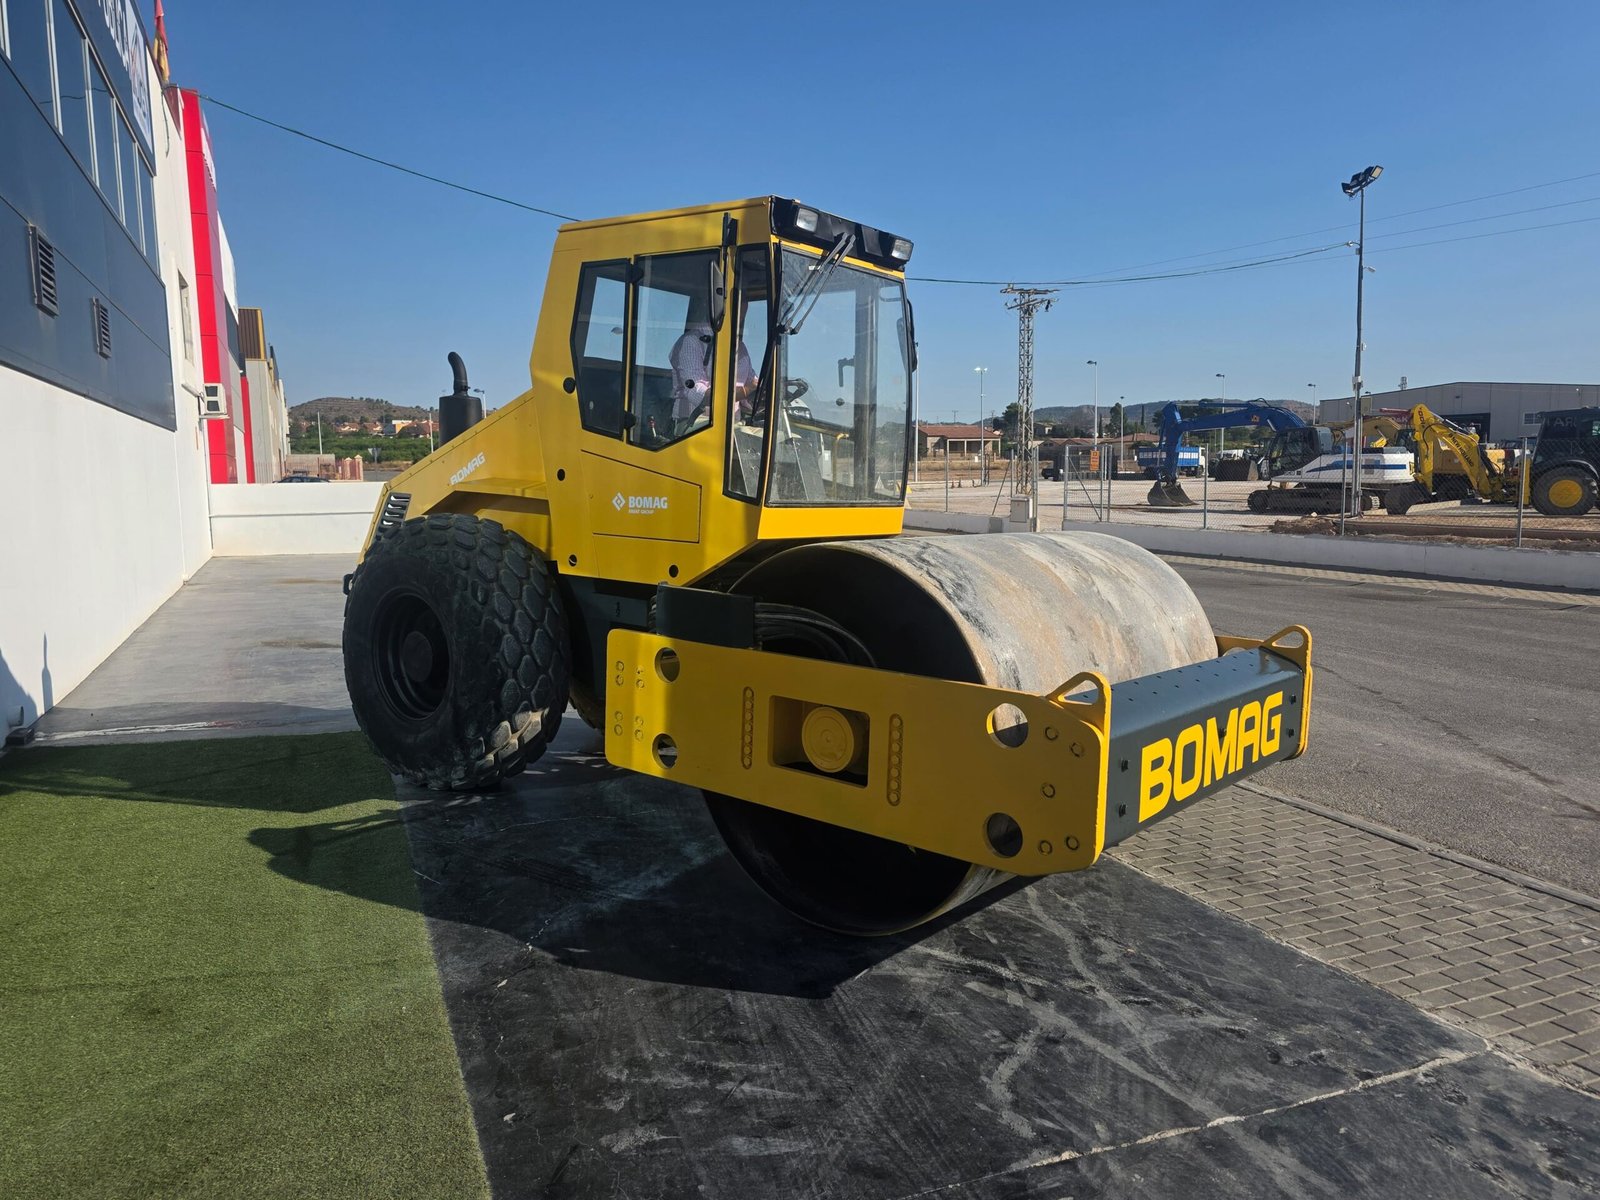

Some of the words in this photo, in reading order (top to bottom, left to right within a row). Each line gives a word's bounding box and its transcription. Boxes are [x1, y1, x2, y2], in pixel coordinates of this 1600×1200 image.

[450, 451, 485, 485] BOMAG
[628, 496, 668, 509] BOMAG
[1138, 690, 1283, 823] BOMAG
